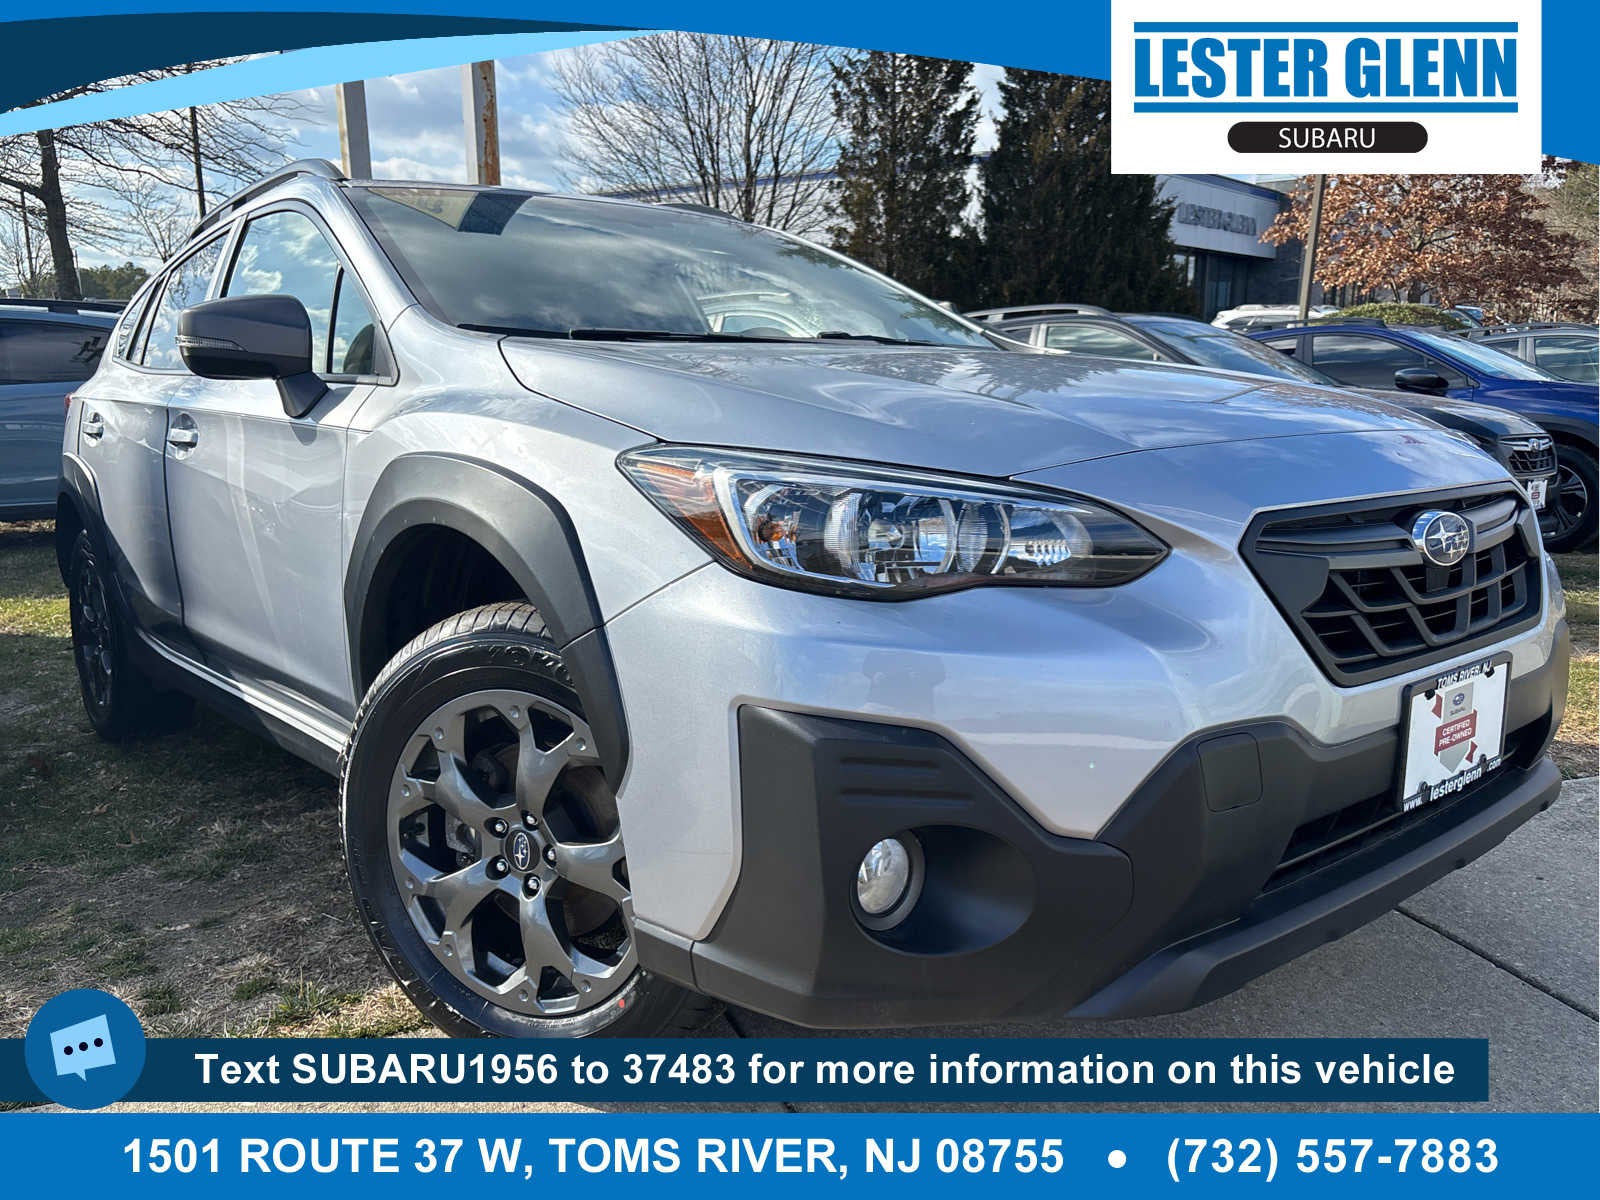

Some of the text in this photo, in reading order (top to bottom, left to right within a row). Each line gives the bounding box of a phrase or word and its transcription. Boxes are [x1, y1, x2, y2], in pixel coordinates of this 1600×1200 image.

[1438, 727, 1472, 747] PRE-OWNED
[1441, 719, 1470, 737] CERTIFIED
[1430, 767, 1482, 802] lesterglenn
